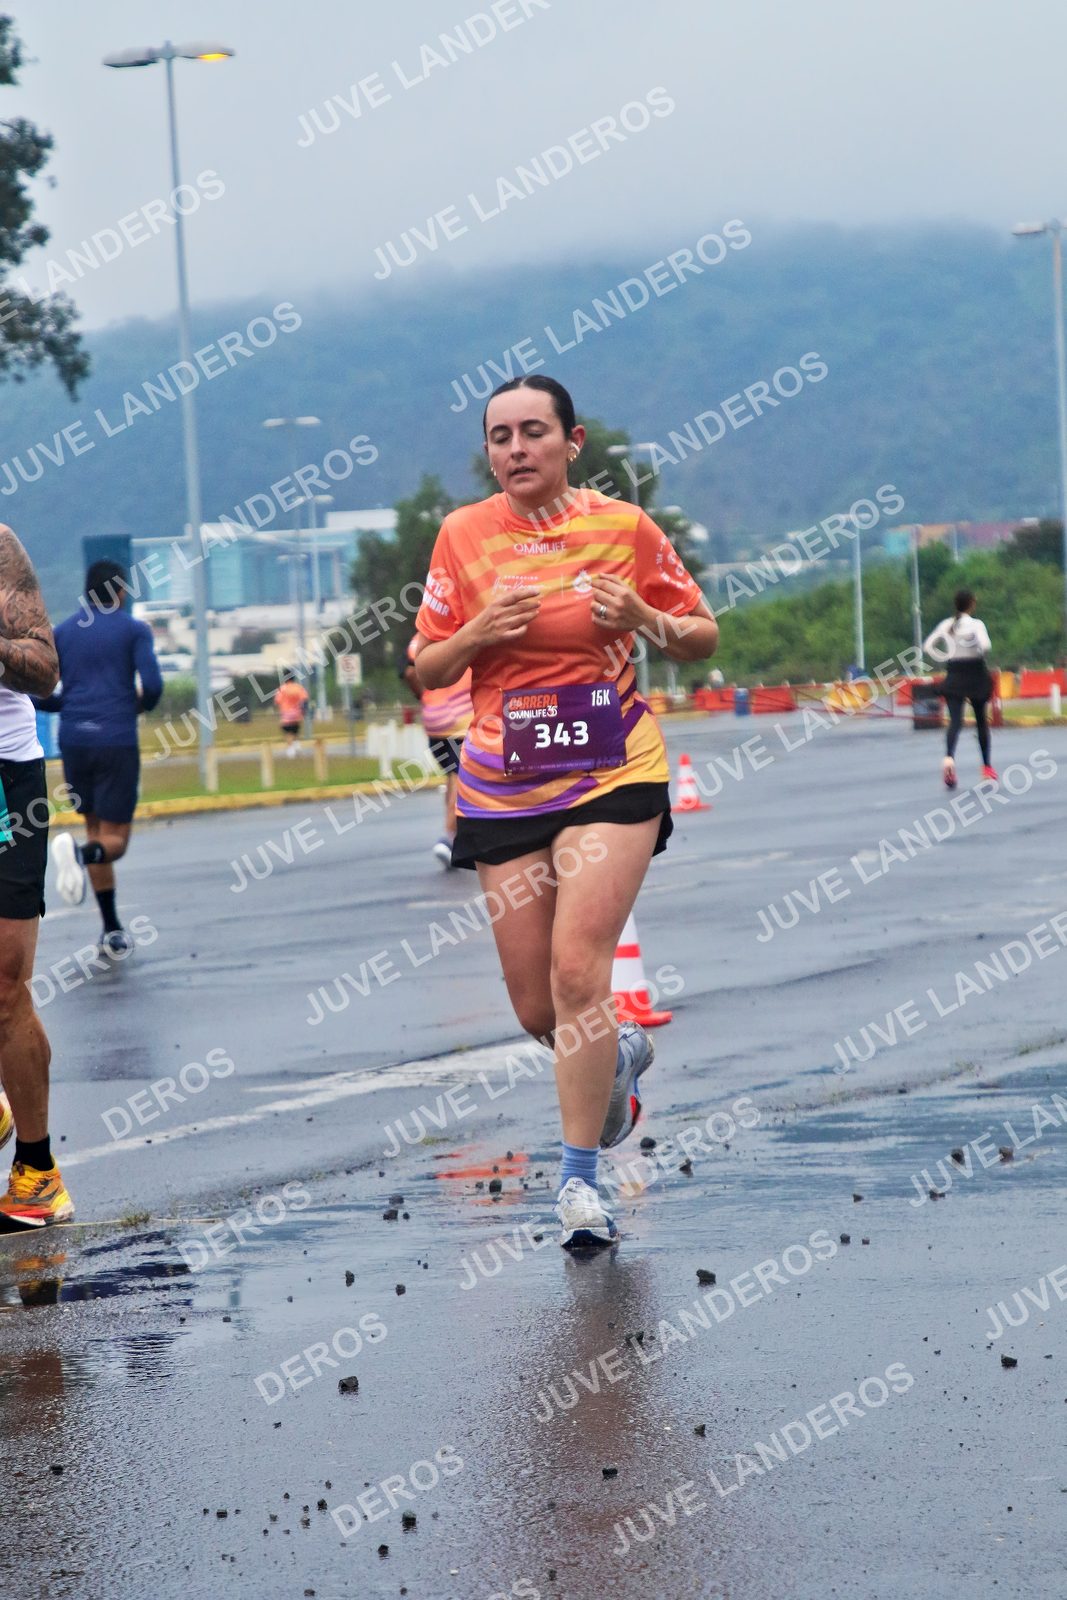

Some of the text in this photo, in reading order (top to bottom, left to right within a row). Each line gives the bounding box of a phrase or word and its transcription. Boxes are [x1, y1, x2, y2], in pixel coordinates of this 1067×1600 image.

[513, 541, 567, 554] OMNILIFE
[509, 694, 558, 710] CARRERA
[534, 720, 589, 749] 343
